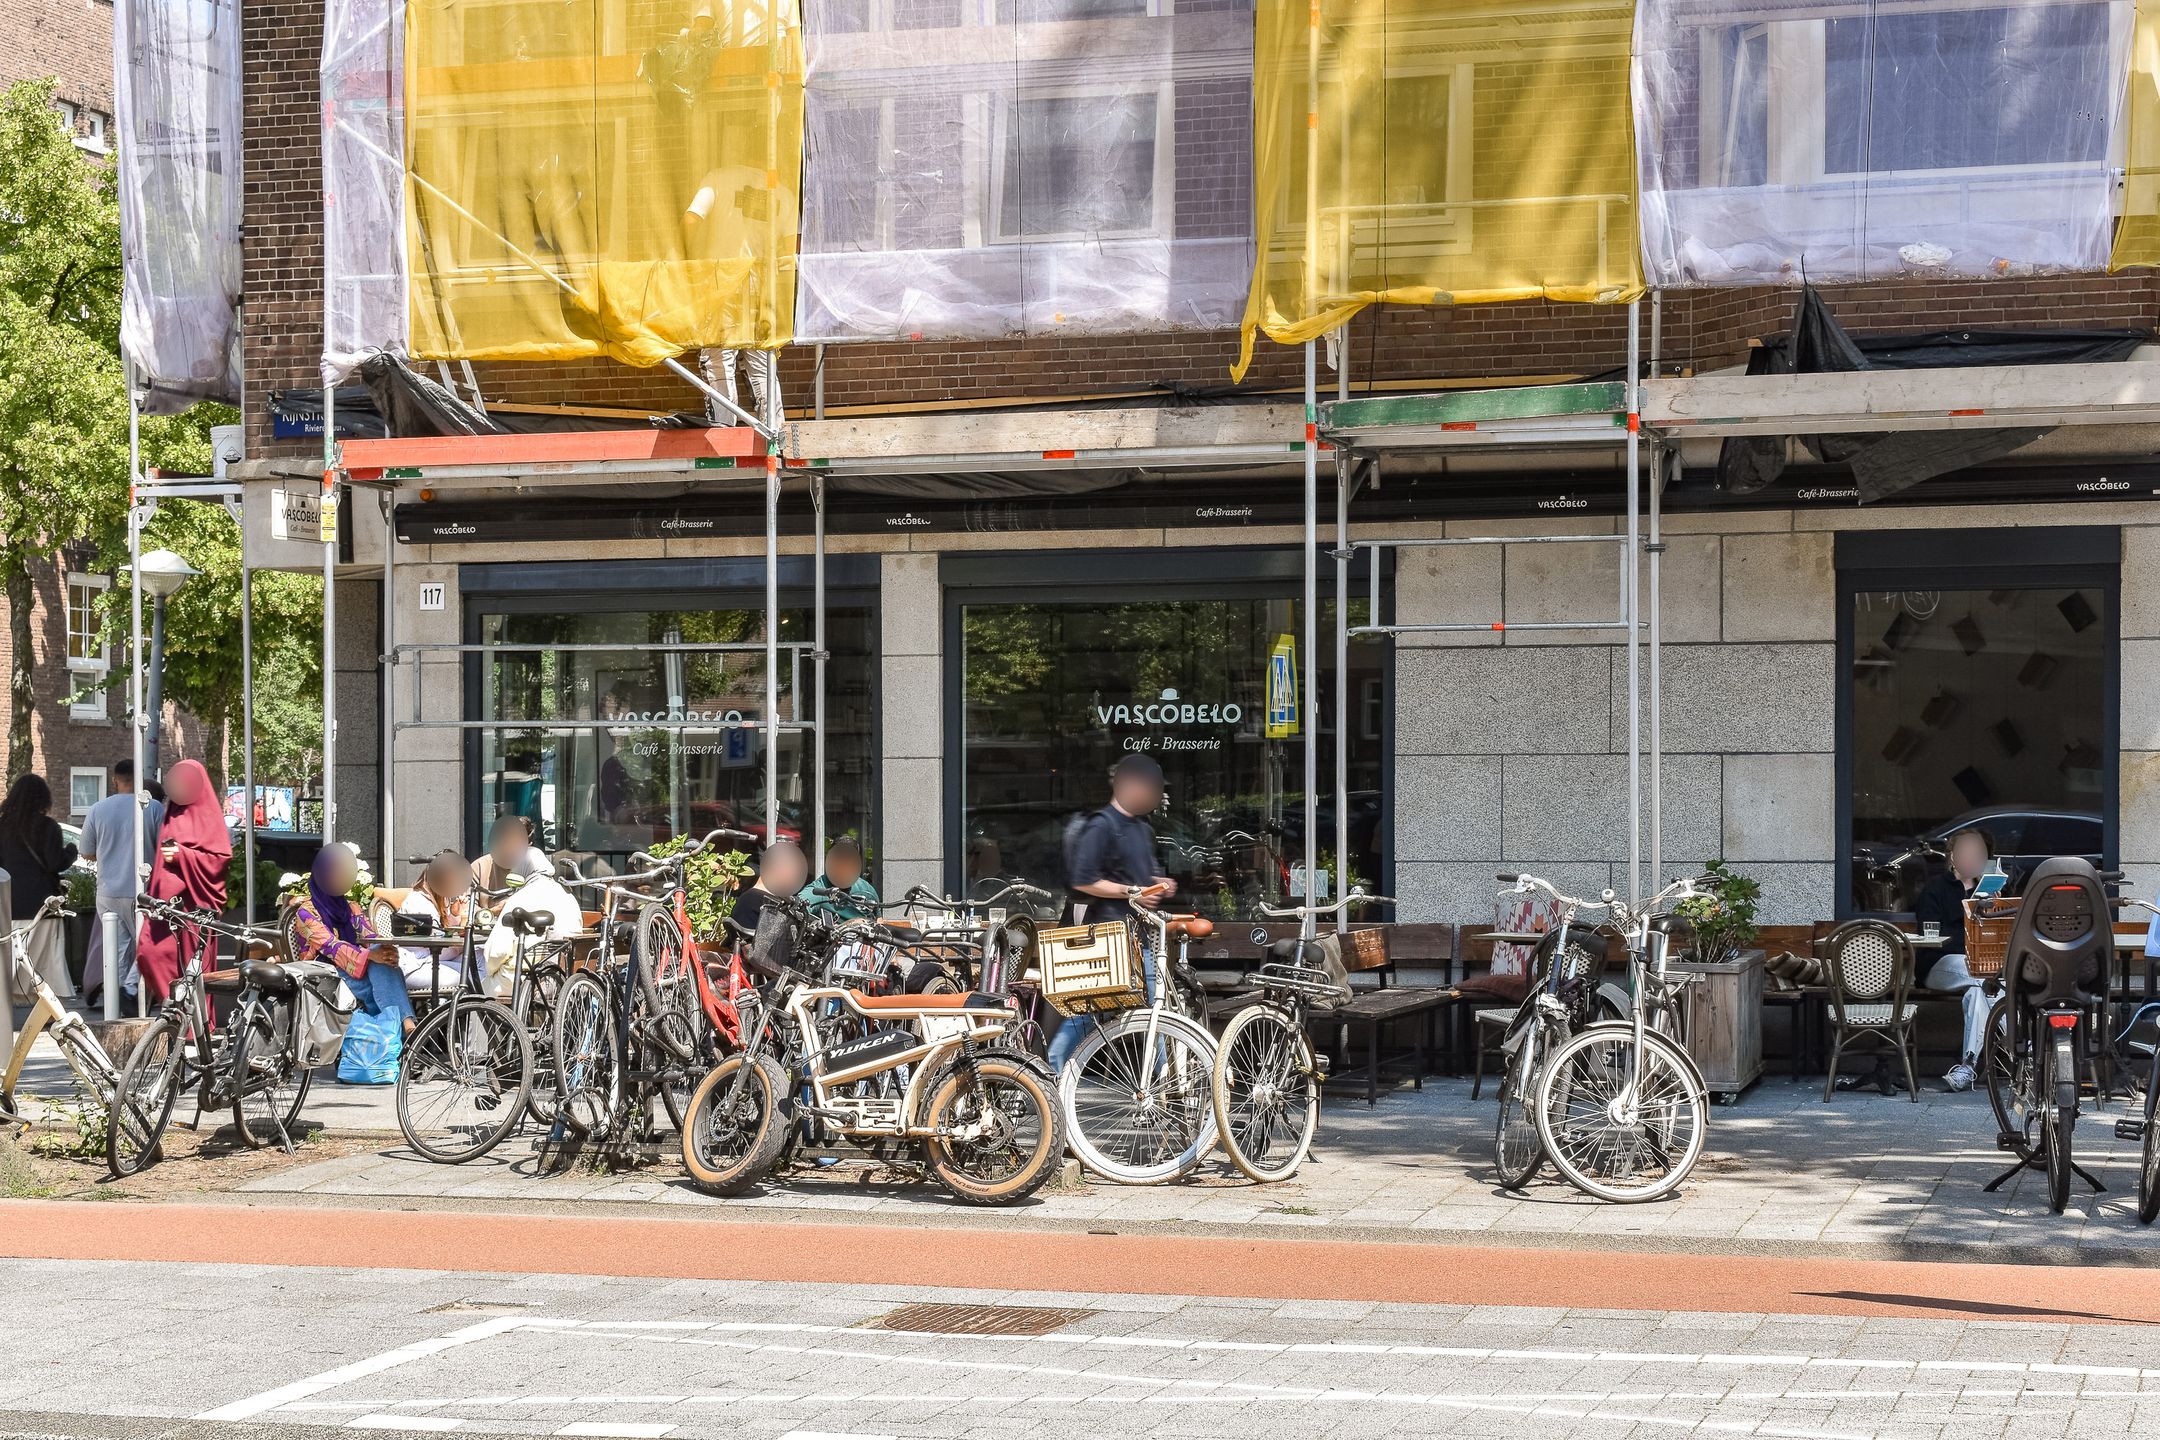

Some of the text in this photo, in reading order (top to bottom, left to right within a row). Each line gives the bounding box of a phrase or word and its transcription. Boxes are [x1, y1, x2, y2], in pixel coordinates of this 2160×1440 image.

[2076, 482, 2130, 491] VASCOBELO
[1537, 500, 1588, 508] VASCOBELO
[1195, 507, 1253, 518] Café-Brasserie
[433, 526, 476, 535] VASCOBELO
[661, 520, 713, 530] Café-Brasserie
[423, 588, 442, 605] 117
[1097, 703, 1242, 726] VASCOBELO
[632, 742, 659, 758] Café
[668, 741, 724, 755] Brasserie
[1123, 737, 1151, 752] Café
[1161, 736, 1221, 750] Brasserie
